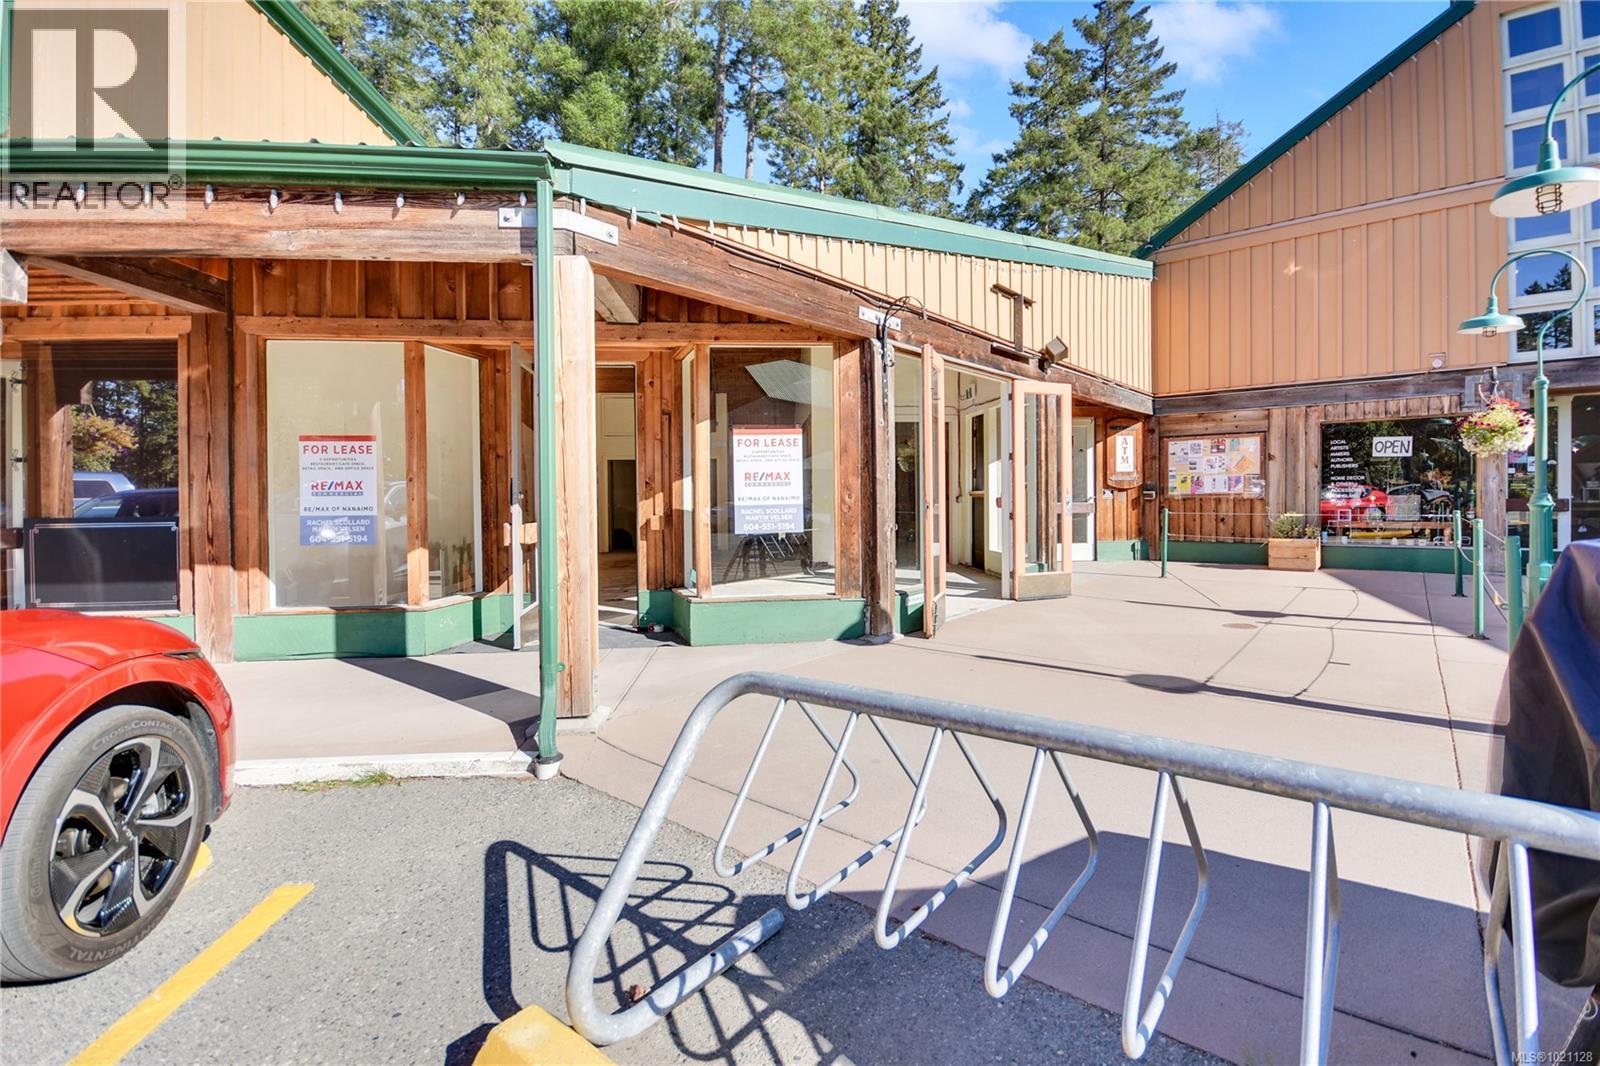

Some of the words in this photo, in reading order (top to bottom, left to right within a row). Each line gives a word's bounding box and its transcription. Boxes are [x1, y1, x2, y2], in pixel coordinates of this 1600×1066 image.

[737, 438, 760, 447] FOR
[764, 438, 799, 447] LEASE
[1374, 440, 1410, 454] OPEN
[303, 445, 329, 455] FOR
[333, 445, 373, 455] LEASE
[1120, 437, 1129, 464] ATM
[744, 472, 791, 481] RE/MAX
[311, 480, 363, 490] RE/MAX
